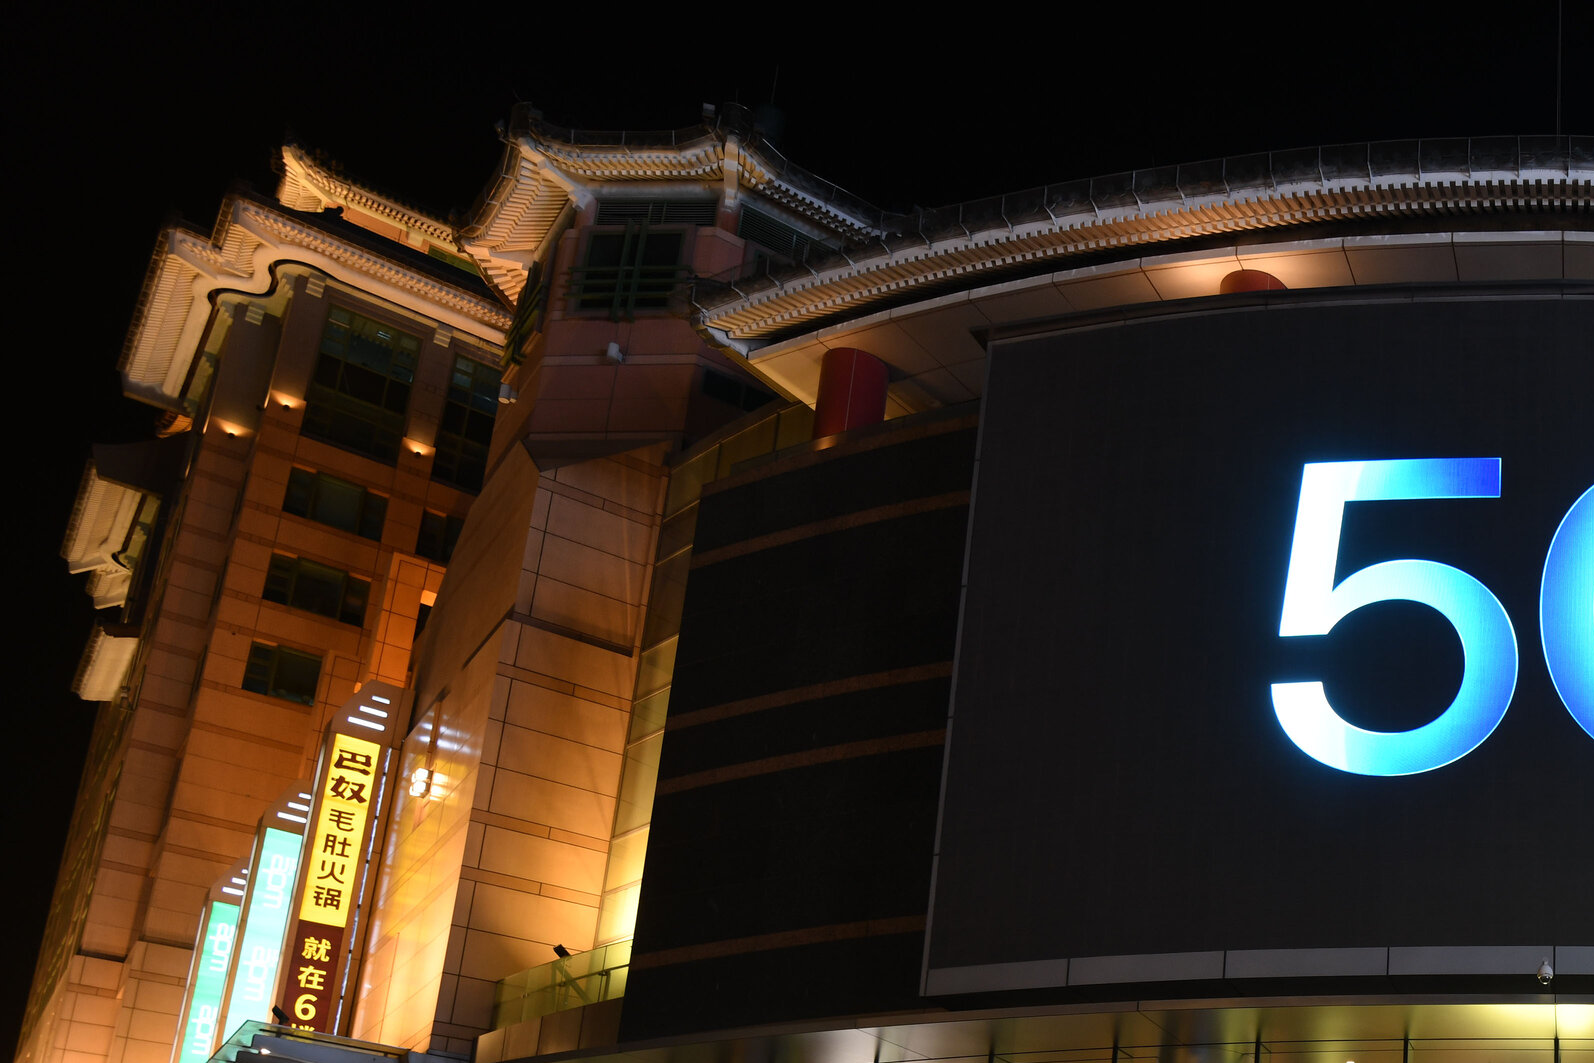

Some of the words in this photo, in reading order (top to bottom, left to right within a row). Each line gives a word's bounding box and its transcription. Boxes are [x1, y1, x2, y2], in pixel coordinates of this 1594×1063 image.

[313, 748, 373, 911] 巴奴毛肚火锅
[291, 935, 332, 1032] 就在6
